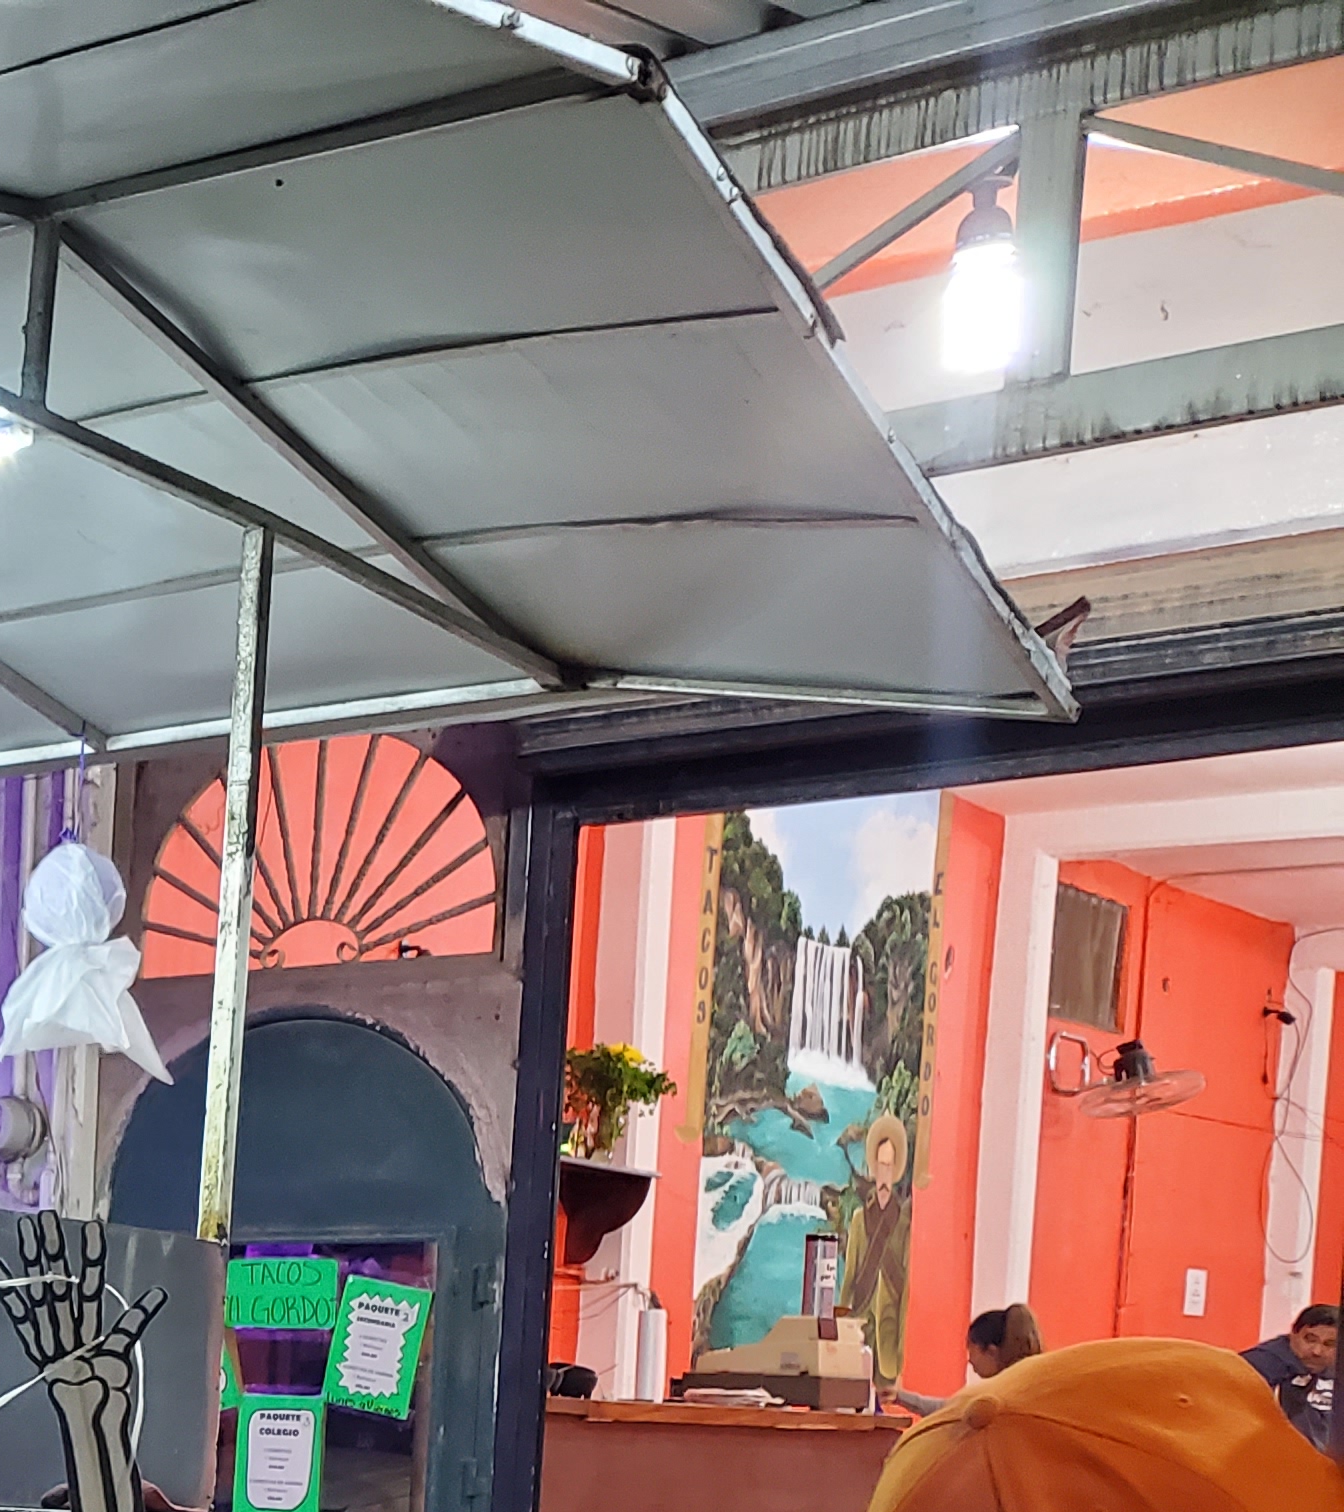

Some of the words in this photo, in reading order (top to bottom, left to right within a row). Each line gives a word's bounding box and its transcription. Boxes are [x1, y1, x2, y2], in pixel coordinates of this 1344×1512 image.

[696, 845, 719, 1025] TACOS
[920, 961, 939, 1117] GORDO
[241, 1261, 322, 1286] TACOS
[357, 1301, 400, 1317] PAQUETE
[259, 1413, 302, 1422] PAQUETE
[258, 1427, 300, 1437] COLEGIO
